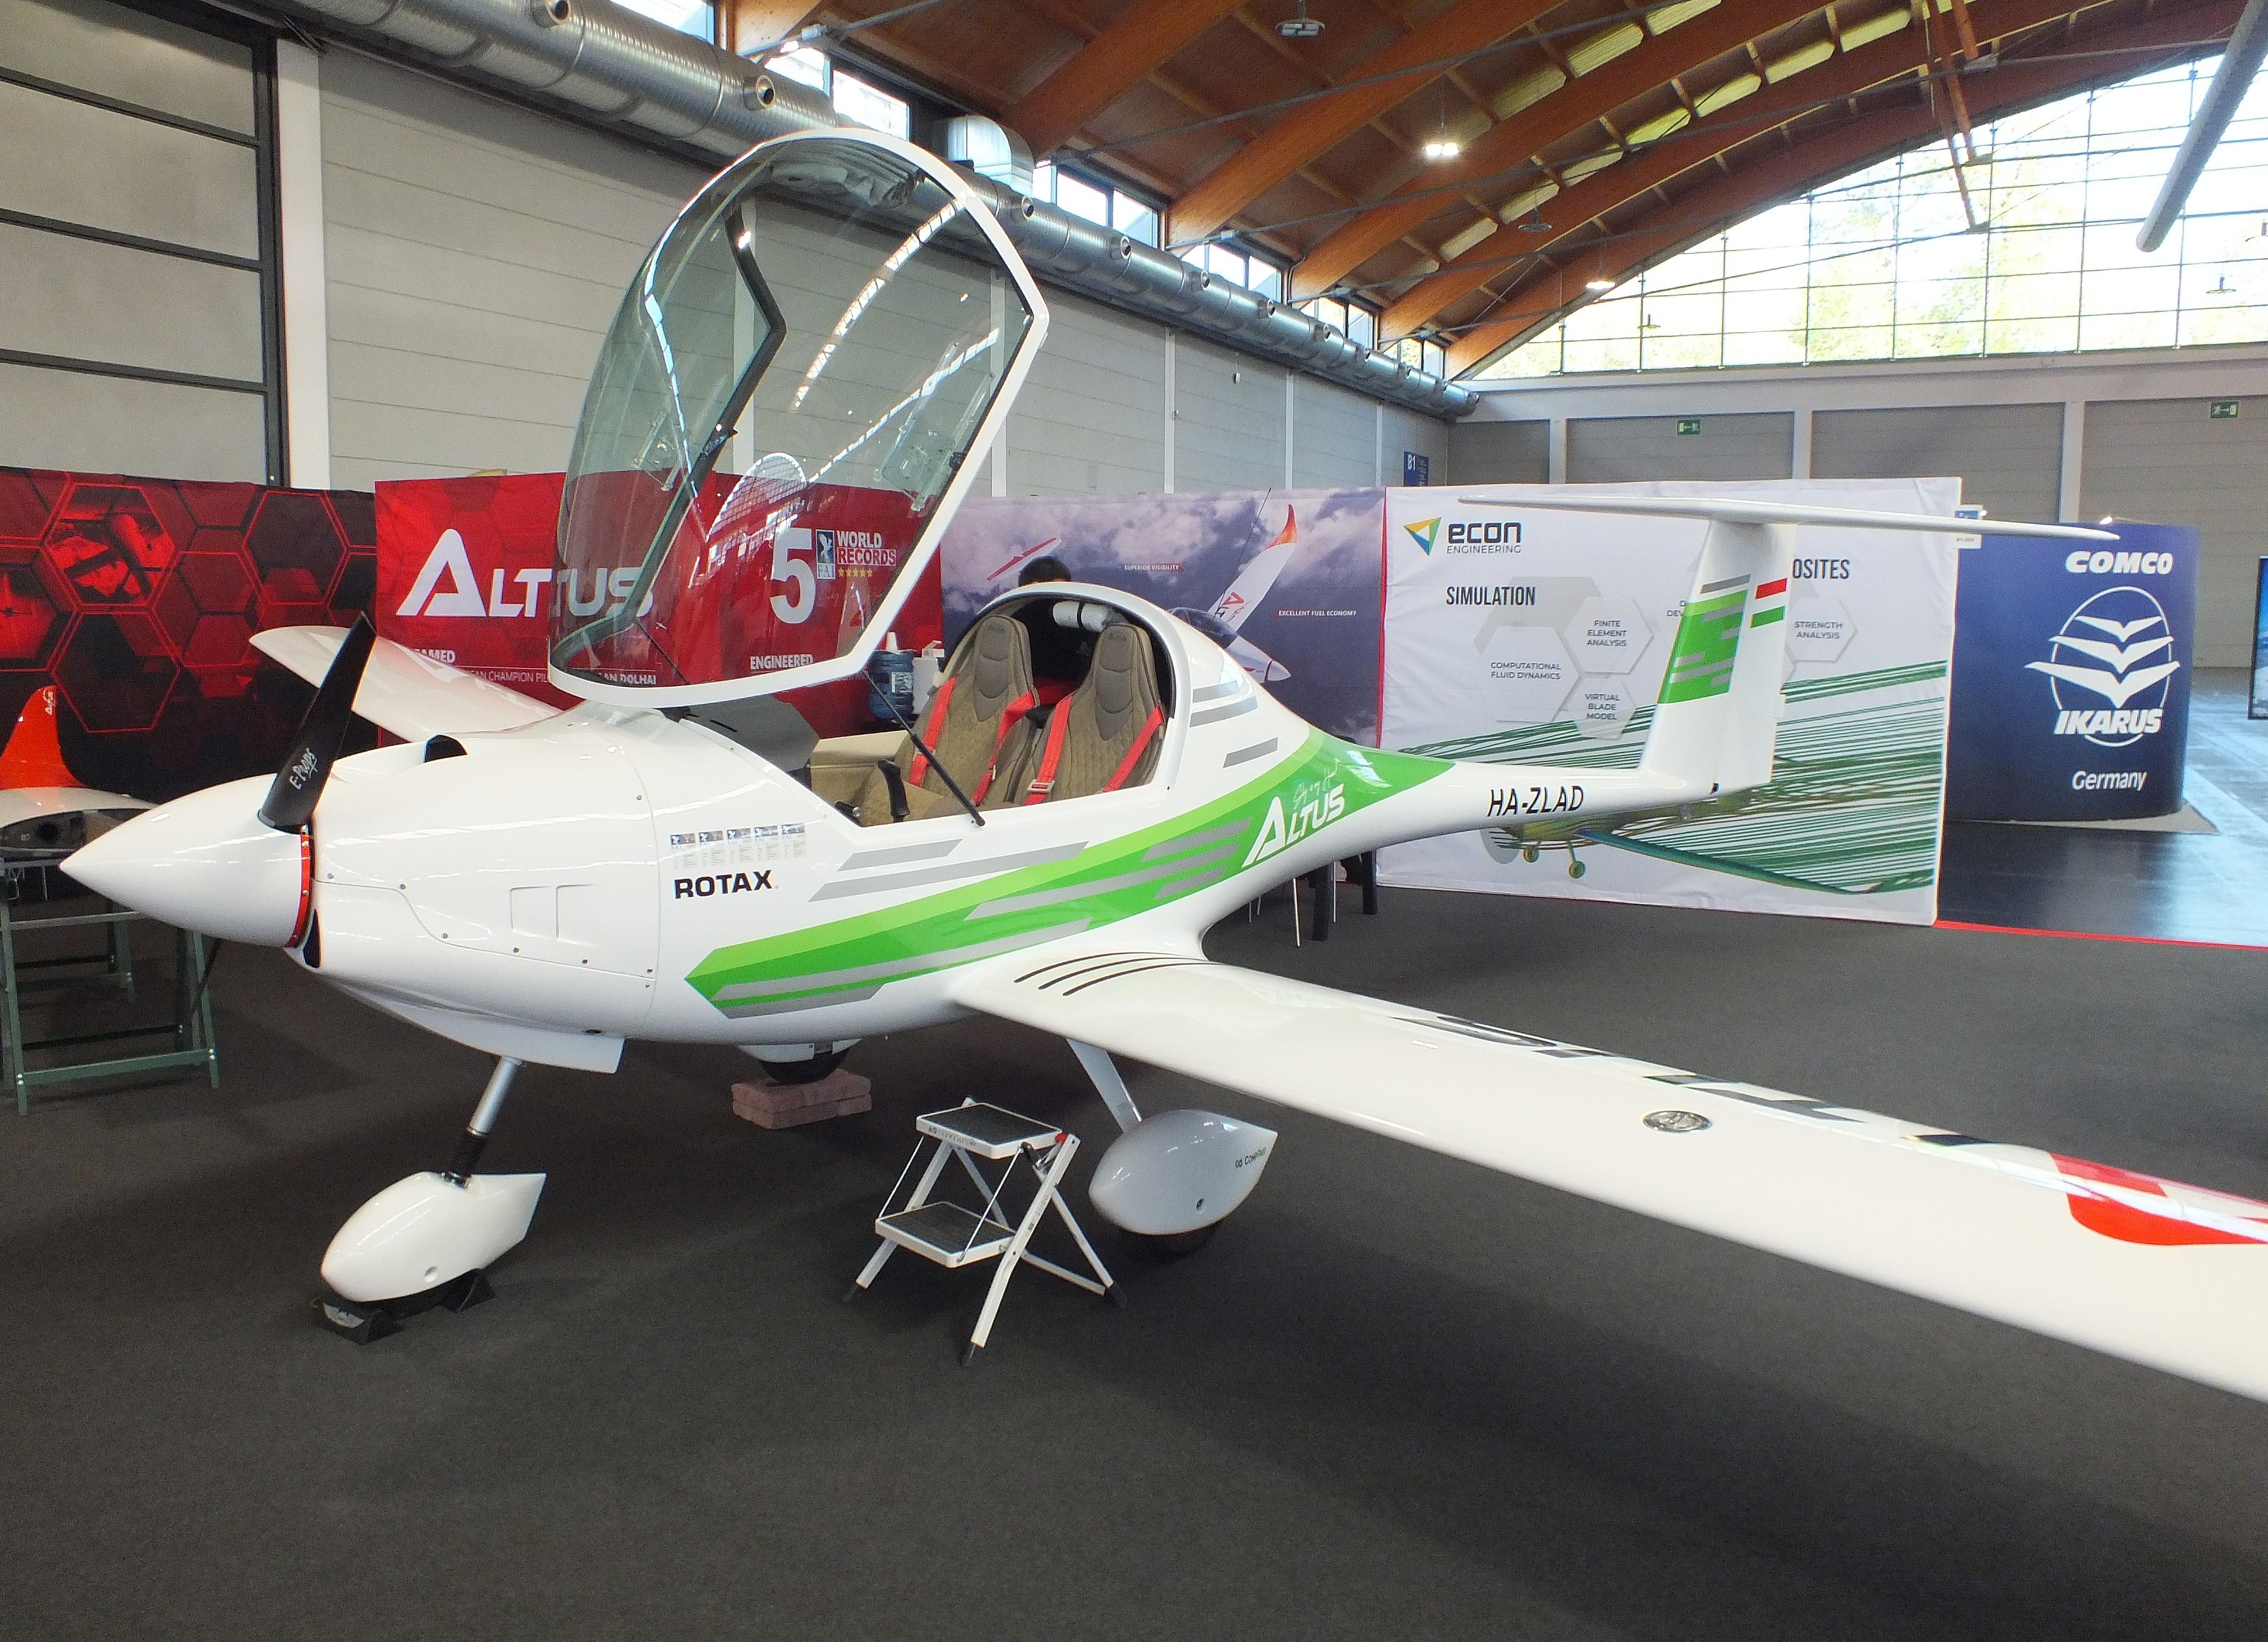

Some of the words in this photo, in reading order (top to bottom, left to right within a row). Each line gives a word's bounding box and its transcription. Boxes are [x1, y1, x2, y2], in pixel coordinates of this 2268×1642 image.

[837, 530, 883, 549] WORLD
[1448, 522, 1522, 544] econ
[838, 548, 897, 566] RECORDS
[1447, 544, 1521, 554] ENGINEERING
[817, 564, 835, 578] FAI
[1792, 558, 1851, 579] OSITES
[2065, 550, 2173, 575] COMCO
[395, 528, 654, 618] ALTUS
[769, 527, 815, 624] 5
[1446, 585, 1537, 606] SIMULATION
[1587, 629, 1627, 637] ELEMENT
[1794, 621, 1843, 629] STRENGTH
[1796, 631, 1840, 639] ANALYSIS
[414, 649, 456, 664] AMED
[750, 654, 813, 670] ENGINEERED
[1490, 661, 1561, 670] COMPUTATIONAL
[488, 670, 534, 682] CHAMPION
[619, 673, 656, 685] DOLHAI
[1516, 671, 1561, 680] DYNAMICS
[1585, 693, 1621, 701] VIRTUAL
[1588, 703, 1616, 711] BLADE
[2053, 708, 2163, 736] IKARUS
[2071, 770, 2148, 791] Germany
[1487, 785, 1586, 817] HA-ZLAD
[1242, 783, 1345, 868] ALTUS
[674, 869, 773, 899] ROTAX
